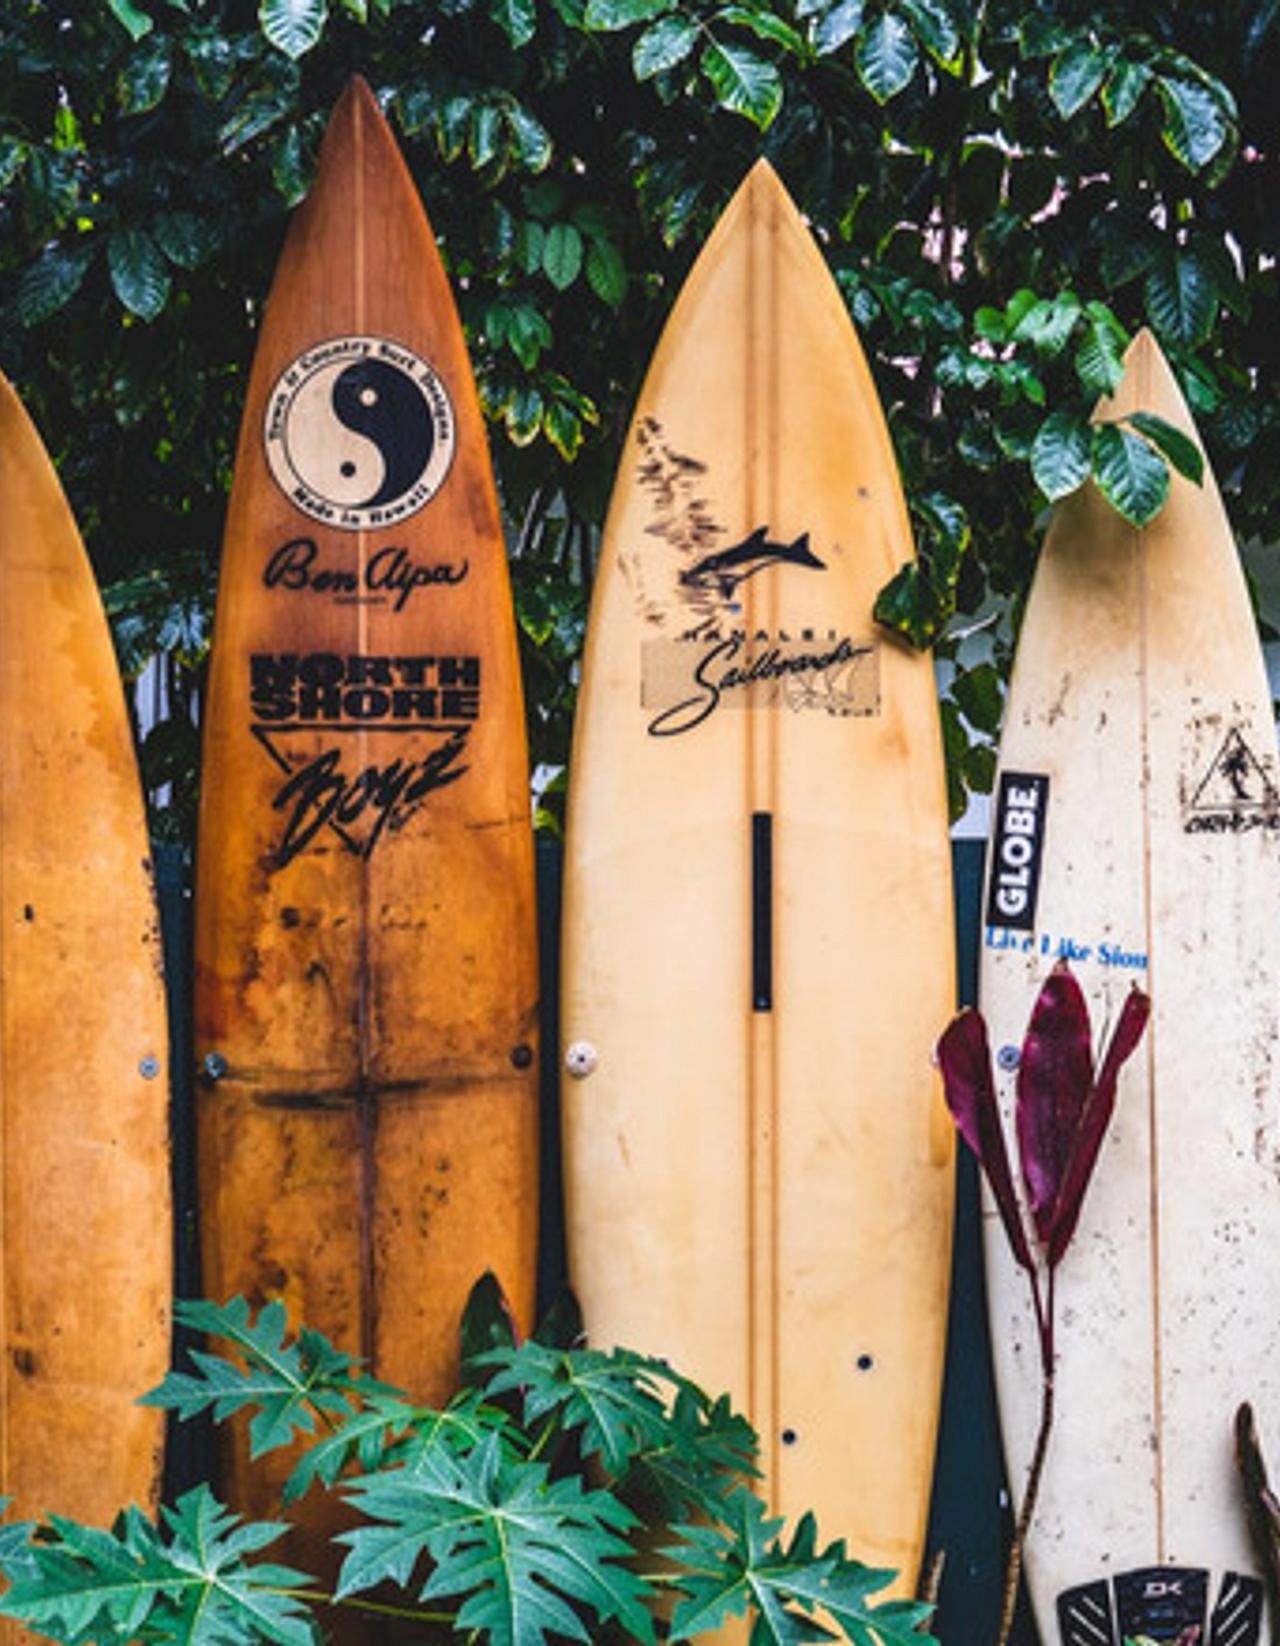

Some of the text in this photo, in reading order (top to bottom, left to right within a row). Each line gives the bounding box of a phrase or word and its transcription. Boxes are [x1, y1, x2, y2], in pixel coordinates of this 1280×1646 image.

[300, 341, 371, 369] Country
[380, 343, 416, 370] Surf
[293, 488, 334, 518] Made
[370, 484, 429, 522] Hawaii
[263, 538, 469, 612] Ben Aipa
[250, 654, 480, 687] NORTH
[250, 687, 480, 720] SHORE
[996, 785, 1039, 916] GLOBE
